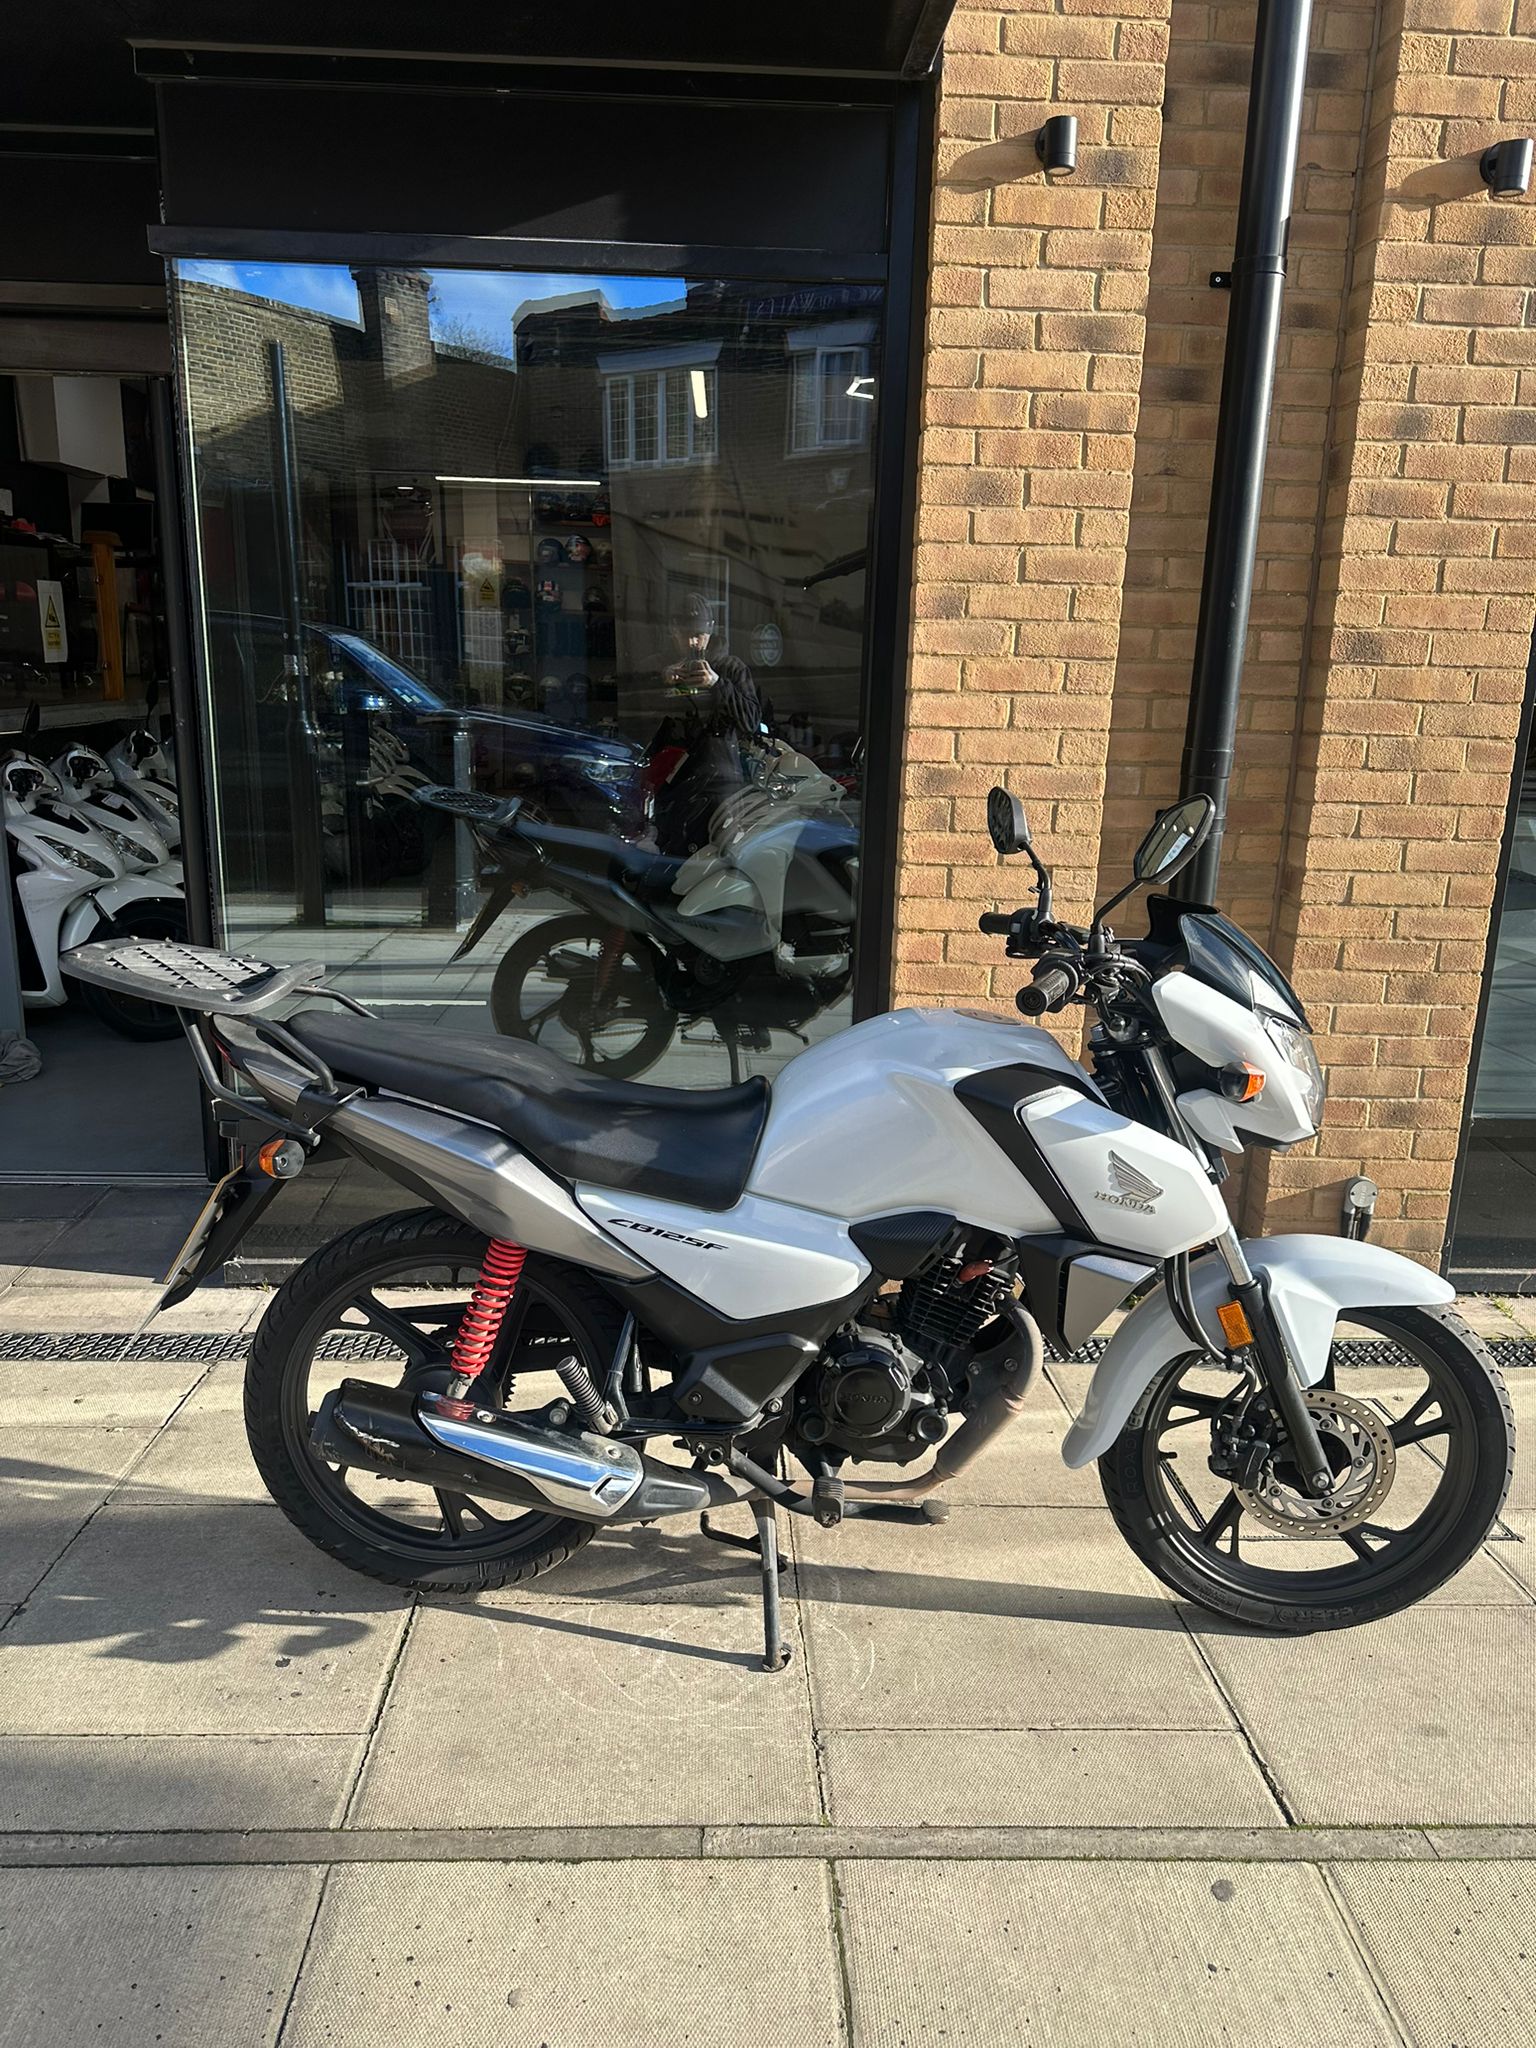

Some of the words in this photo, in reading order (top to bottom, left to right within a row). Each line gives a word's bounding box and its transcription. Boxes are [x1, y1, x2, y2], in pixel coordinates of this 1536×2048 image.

[1094, 1191, 1156, 1215] HONDA
[607, 1218, 729, 1250] CB125F
[840, 1391, 890, 1404] HONDA
